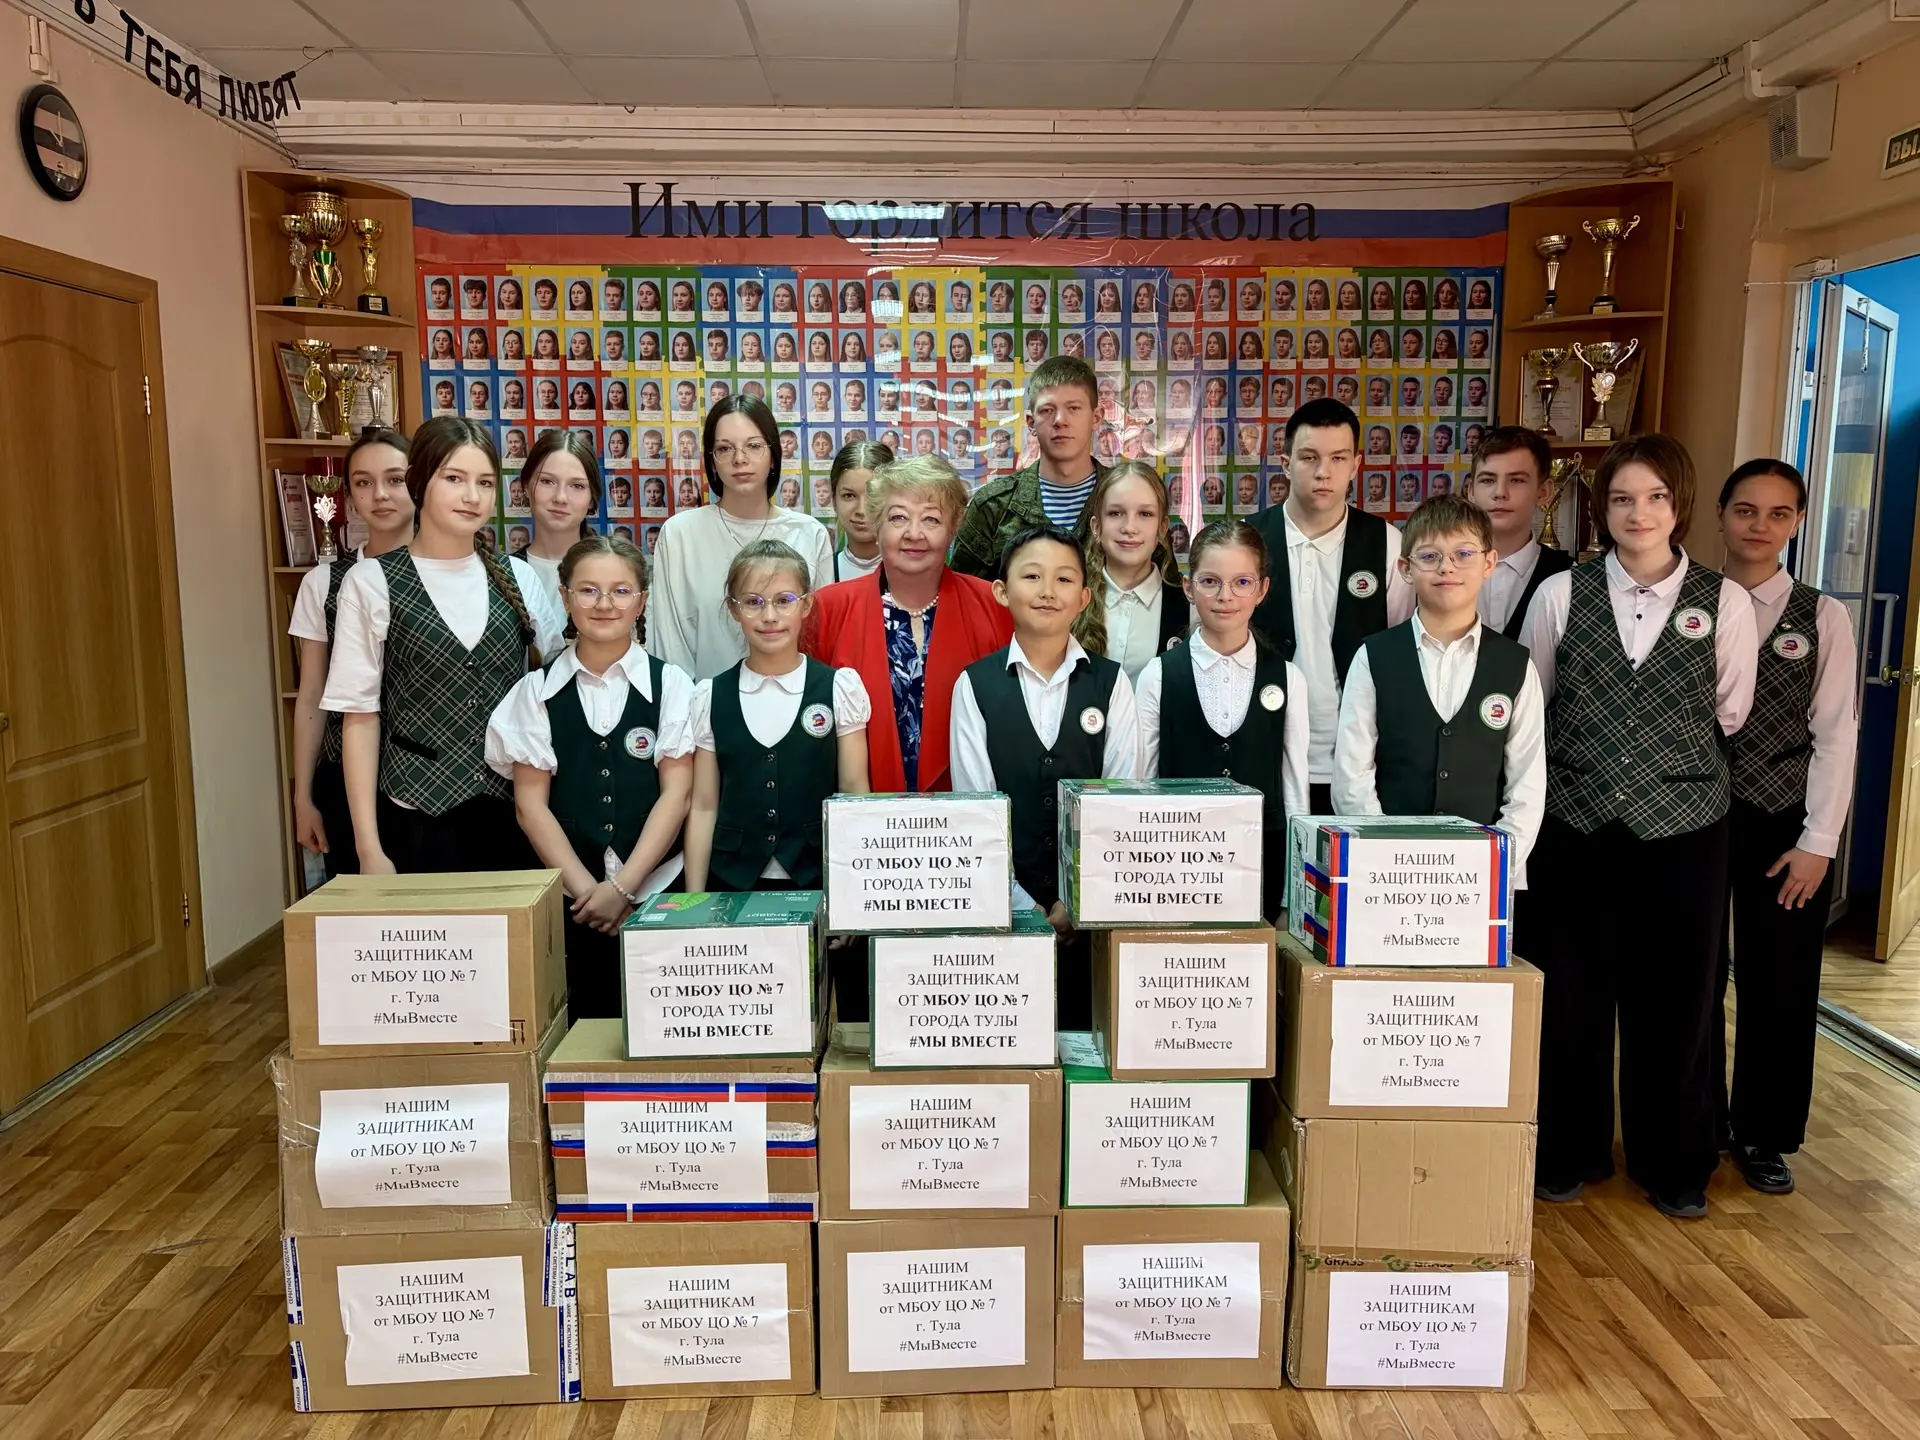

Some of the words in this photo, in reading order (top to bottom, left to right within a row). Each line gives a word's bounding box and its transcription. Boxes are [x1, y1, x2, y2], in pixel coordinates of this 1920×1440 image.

[120, 9, 201, 109] ТЕБЯ
[218, 70, 302, 122] ЛЮБЯТ
[1890, 133, 1920, 163] ВЫ
[623, 182, 774, 238] Ими
[1115, 202, 1320, 241] школа
[886, 816, 948, 830] НАШИМ
[1139, 811, 1202, 824] НАШИМ
[861, 835, 973, 851] ЗАЩИТНИКАМ
[1113, 830, 1226, 845] ЗАЩИТНИКАМ
[851, 857, 873, 871] ОТ
[876, 856, 925, 870] МБОУ
[928, 856, 953, 871] ЦО
[955, 856, 971, 869] №
[1103, 850, 1125, 863] ОТ
[1128, 851, 1177, 864] МБОУ
[1181, 851, 1205, 866] ЦО
[1207, 851, 1224, 864] №
[1394, 853, 1455, 866] НАШИМ
[863, 877, 925, 893] ГОРОДА
[927, 877, 972, 890] ТУЛЫ
[1114, 871, 1177, 887] ГОРОДА
[1179, 871, 1224, 885] ТУЛЫ
[1369, 871, 1478, 887] ЗАЩИТНИКАМ
[863, 899, 901, 912] #МЫ
[905, 897, 972, 911] ВМЕСТЕ
[1114, 891, 1153, 905] #МЫ
[1156, 892, 1223, 905] ВМЕСТЕ
[1364, 895, 1379, 905] от
[1383, 892, 1427, 905] МБОУ
[1430, 893, 1453, 907] ЦО
[1454, 893, 1470, 905] №
[1413, 913, 1445, 929] Тула
[381, 929, 447, 942] НАШИМ
[1383, 933, 1460, 946] #МыВместе
[353, 948, 473, 964] ЗАЩИТНИКАМ
[684, 943, 748, 958] НАШИМ
[933, 953, 995, 967] НАШИМ
[1164, 957, 1226, 970] НАШИМ
[351, 973, 368, 983] от
[371, 969, 419, 983] МБОУ
[422, 969, 447, 985] ЦО
[449, 969, 466, 982] №
[658, 962, 774, 979] ЗАЩИТНИКАМ
[907, 973, 1019, 988] ЗАЩИТНИКАМ
[1138, 975, 1250, 991] ЗАЩИТНИКАМ
[405, 990, 440, 1007] Тула
[649, 985, 672, 999] ОТ
[675, 984, 725, 998] МБОУ
[728, 983, 753, 998] ЦО
[755, 983, 773, 995] №
[897, 994, 919, 1007] ОТ
[922, 993, 971, 1007] МБОУ
[974, 993, 999, 1009] ЦО
[1001, 993, 1018, 1007] №
[1135, 999, 1151, 1009] от
[1153, 996, 1198, 1009] МБОУ
[1201, 996, 1224, 1011] ЦО
[1226, 996, 1242, 1009] №
[1392, 994, 1455, 1008] НАШИМ
[373, 1011, 458, 1025] #МыВместе
[662, 1004, 725, 1019] ГОРОДА
[728, 1003, 773, 1017] ТУЛЫ
[909, 1014, 971, 1029] ГОРОДА
[973, 1014, 1018, 1027] ТУЛЫ
[1185, 1017, 1217, 1033] Тула
[1367, 1012, 1479, 1028] ЗАЩИТНИКАМ
[663, 1025, 701, 1039] #МЫ
[705, 1023, 774, 1038] ВМЕСТЕ
[909, 1035, 947, 1048] #МЫ
[951, 1035, 1017, 1048] ВМЕСТЕ
[1154, 1037, 1233, 1050] #МыВместе
[1362, 1036, 1379, 1046] от
[1381, 1033, 1427, 1047] МБОУ
[1429, 1034, 1452, 1049] ЦО
[1454, 1035, 1471, 1047] №
[1412, 1054, 1445, 1070] Тула
[1381, 1075, 1460, 1088] #МыВместе
[646, 1101, 709, 1114] НАШИМ
[910, 1097, 972, 1111] НАШИМ
[1130, 1097, 1191, 1109] НАШИМ
[620, 1120, 733, 1136] ЗАЩИТНИКАМ
[884, 1116, 996, 1132] ЗАЩИТНИКАМ
[1105, 1115, 1215, 1131] ЗАЩИТНИКАМ
[617, 1145, 633, 1155] от
[635, 1141, 681, 1154] МБОУ
[684, 1141, 707, 1156] ЦО
[709, 1141, 726, 1154] №
[881, 1141, 897, 1151] от
[899, 1137, 945, 1150] МБОУ
[947, 1137, 971, 1152] ЦО
[973, 1137, 989, 1150] №
[1101, 1139, 1117, 1149] от
[1119, 1136, 1164, 1149] МБОУ
[1167, 1135, 1189, 1151] ЦО
[1191, 1135, 1207, 1148] №
[668, 1161, 702, 1176] Тула
[931, 1158, 964, 1173] Тула
[1150, 1156, 1183, 1171] Тула
[639, 1179, 719, 1191] #МыВместе
[901, 1178, 980, 1190] #МыВместе
[1119, 1176, 1198, 1188] #МыВместе
[907, 1261, 969, 1275] НАШИМ
[400, 1271, 464, 1287] НАШИМ
[882, 1278, 993, 1295] ЗАЩИТНИКАМ
[375, 1288, 491, 1308] ЗАЩИТНИКАМ
[879, 1305, 895, 1315] от
[897, 1300, 942, 1314] МБОУ
[945, 1299, 968, 1313] ЦО
[970, 1298, 986, 1311] №
[373, 1317, 389, 1327] от
[392, 1311, 439, 1326] МБОУ
[441, 1309, 465, 1325] ЦО
[468, 1308, 484, 1321] №
[929, 1319, 961, 1334] Тула
[426, 1331, 461, 1346] Тула
[899, 1339, 977, 1352] #МыВместе
[397, 1350, 478, 1365] #МыВместе
